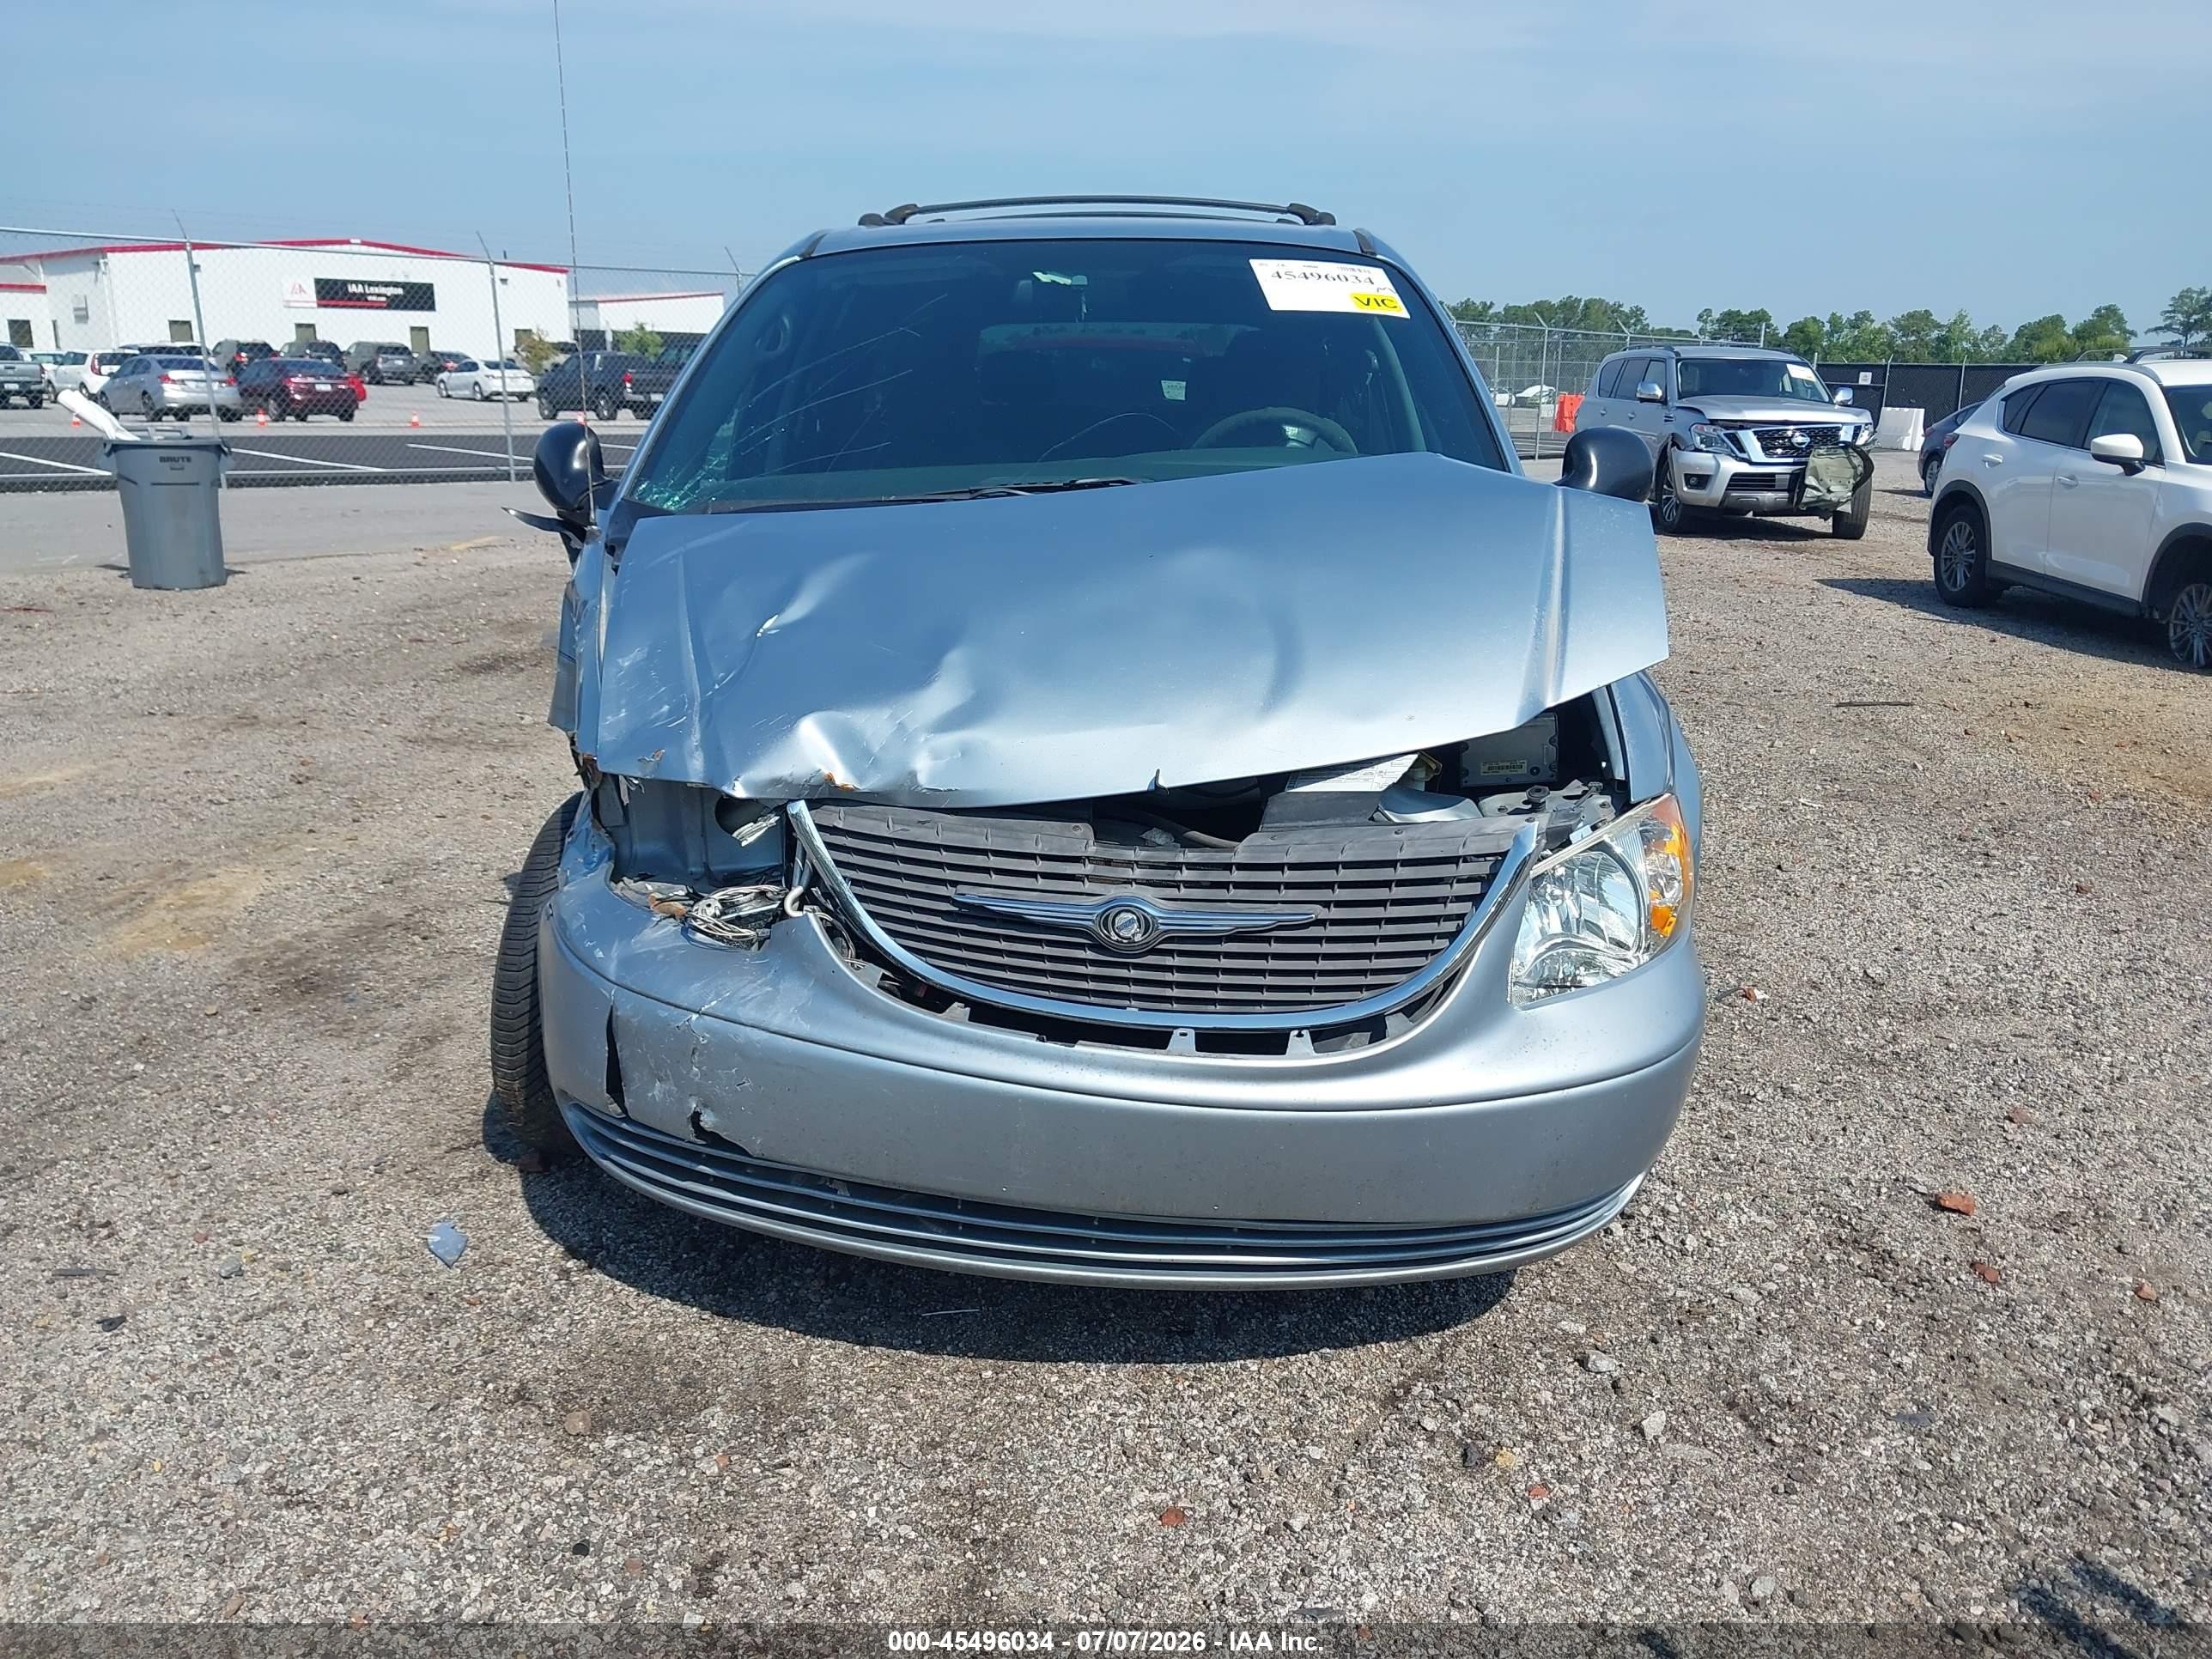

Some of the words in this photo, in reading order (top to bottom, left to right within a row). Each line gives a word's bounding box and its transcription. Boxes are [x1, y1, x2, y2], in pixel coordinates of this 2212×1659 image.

[1271, 270, 1375, 286] 45496034
[347, 283, 364, 294] IAA
[365, 283, 404, 296] Lexington
[1354, 295, 1398, 309] VIC
